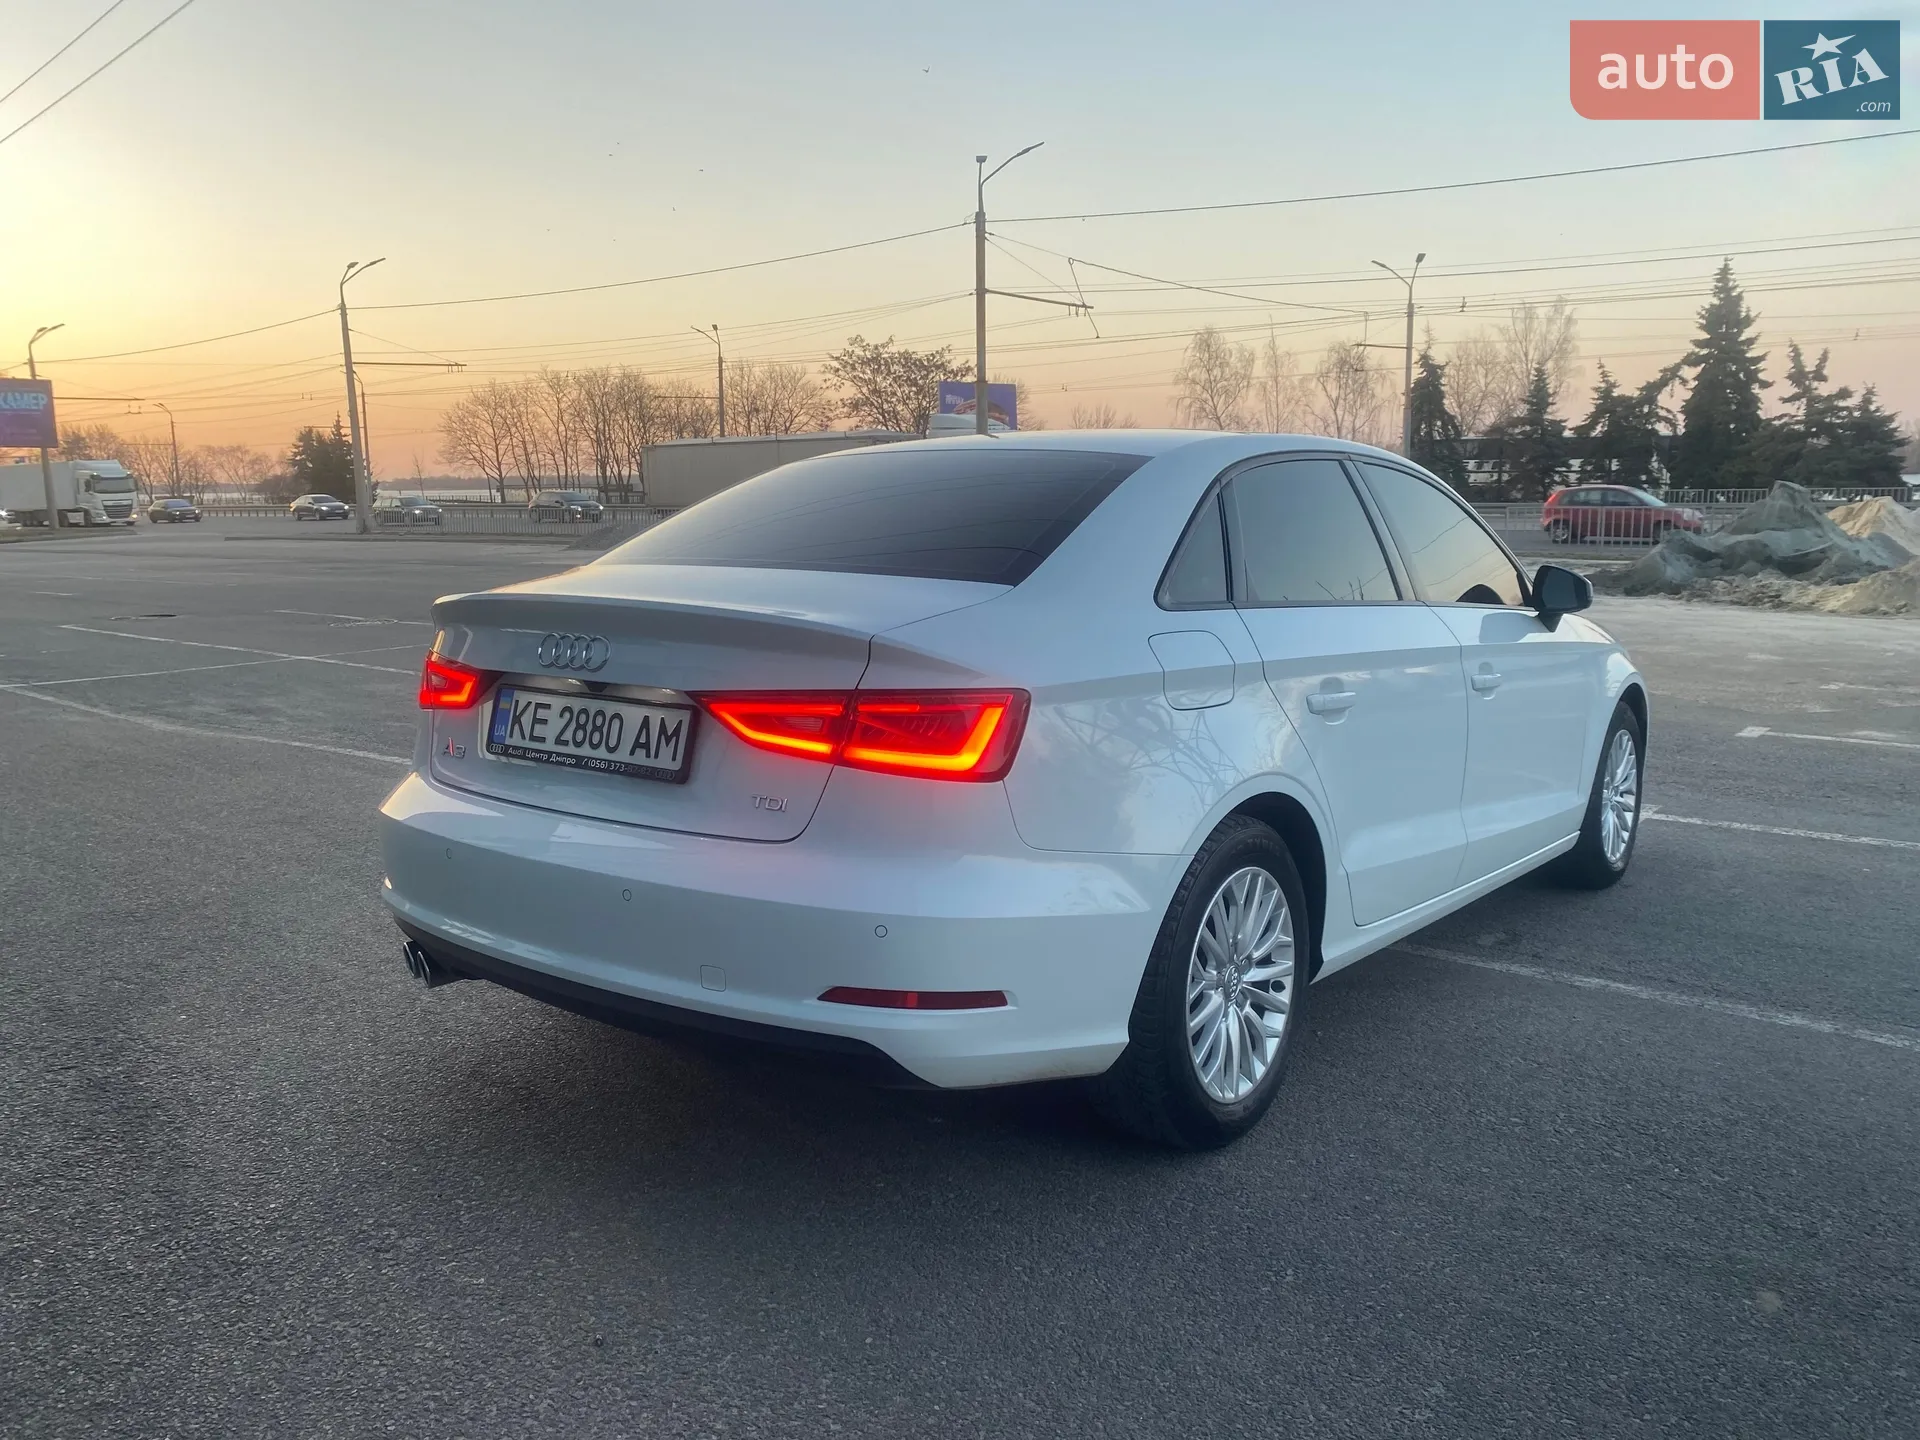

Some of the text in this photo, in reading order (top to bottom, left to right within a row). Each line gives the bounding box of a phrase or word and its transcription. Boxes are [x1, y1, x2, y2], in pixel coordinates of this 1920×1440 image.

[494, 724, 506, 736] UA
[509, 699, 683, 762] KE 2880 AM
[442, 736, 466, 759] A3
[508, 747, 524, 755] Audi
[525, 750, 548, 761] Центр
[549, 755, 576, 765] Дніпро
[588, 758, 608, 770] (056)
[751, 793, 788, 812] TDI
